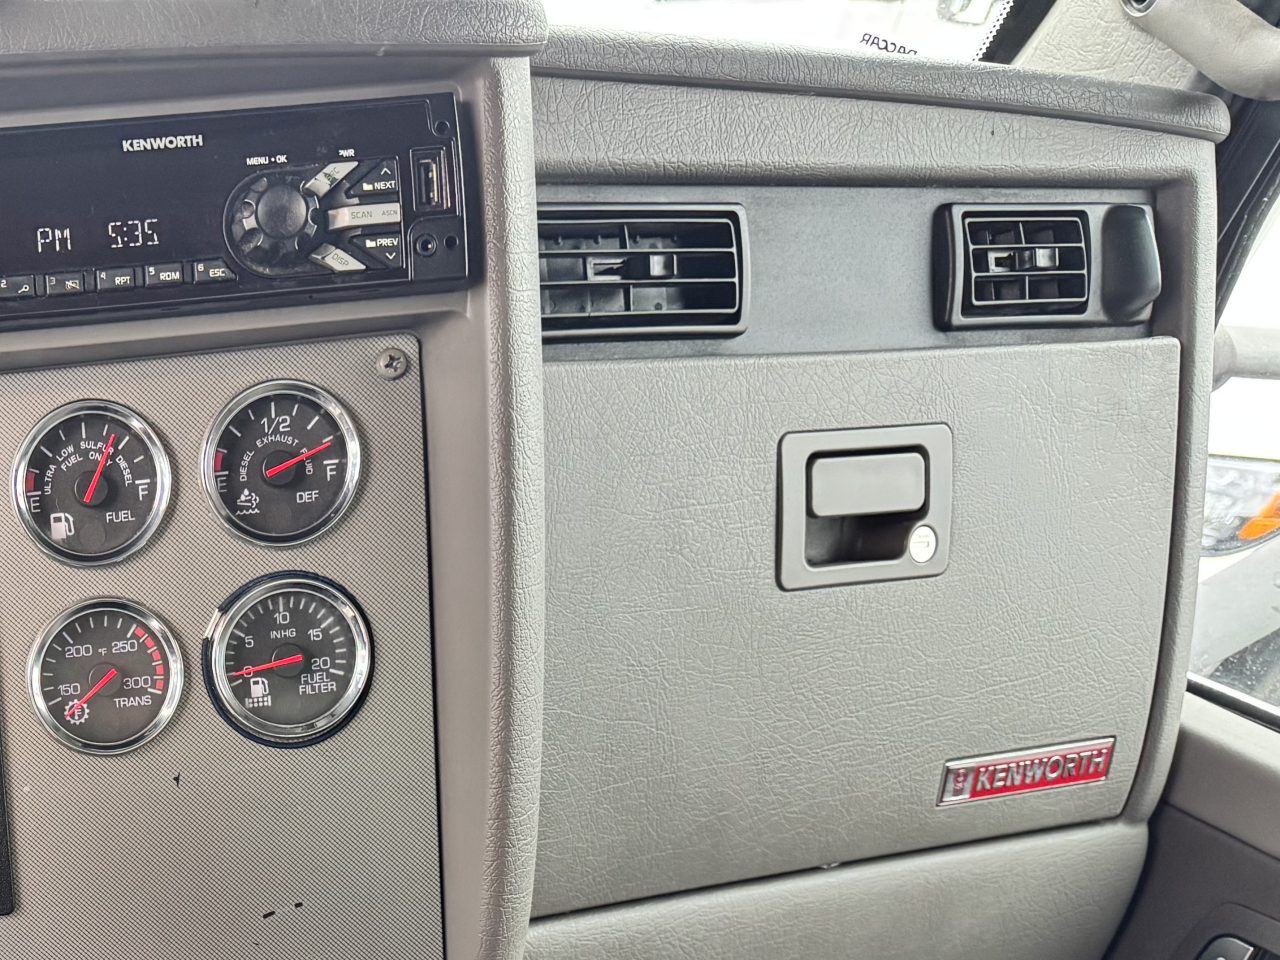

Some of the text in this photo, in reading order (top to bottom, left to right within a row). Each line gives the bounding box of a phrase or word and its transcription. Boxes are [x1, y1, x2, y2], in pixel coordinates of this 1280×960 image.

[122, 135, 203, 152] KENWORTH
[247, 155, 288, 165] MENU OK
[374, 181, 396, 190] NEXT
[351, 211, 372, 219] SCAN
[37, 219, 159, 252] PM 5:35
[376, 238, 398, 247] PREV
[332, 253, 349, 266] DISP
[149, 267, 155, 275] 5
[198, 264, 225, 277] 6 ESC
[0, 280, 7, 288] 2
[50, 277, 56, 285] 3
[100, 272, 130, 286] 4 RPT
[260, 416, 290, 434] 1/2
[61, 452, 113, 471] FUEL ONY
[240, 434, 313, 481] DIESEL EXHAUST FUID
[44, 464, 57, 495] ULTRA
[56, 444, 74, 461] LOW
[116, 455, 133, 487] DIESEL
[327, 465, 336, 481] F
[138, 485, 148, 501] F
[296, 490, 319, 503] DEF
[30, 497, 40, 512] E
[106, 510, 135, 523] FUEL
[274, 612, 290, 624] 10
[308, 629, 322, 641] 15
[112, 640, 137, 653] 250
[245, 636, 254, 648] 5
[65, 644, 92, 658] 200
[311, 657, 330, 670] 20
[123, 676, 151, 689] 300
[301, 672, 330, 684] FUEL
[58, 683, 80, 696] 150
[299, 682, 336, 695] FILTER
[113, 695, 152, 708] TRANS
[976, 749, 1108, 791] KENWORTH
